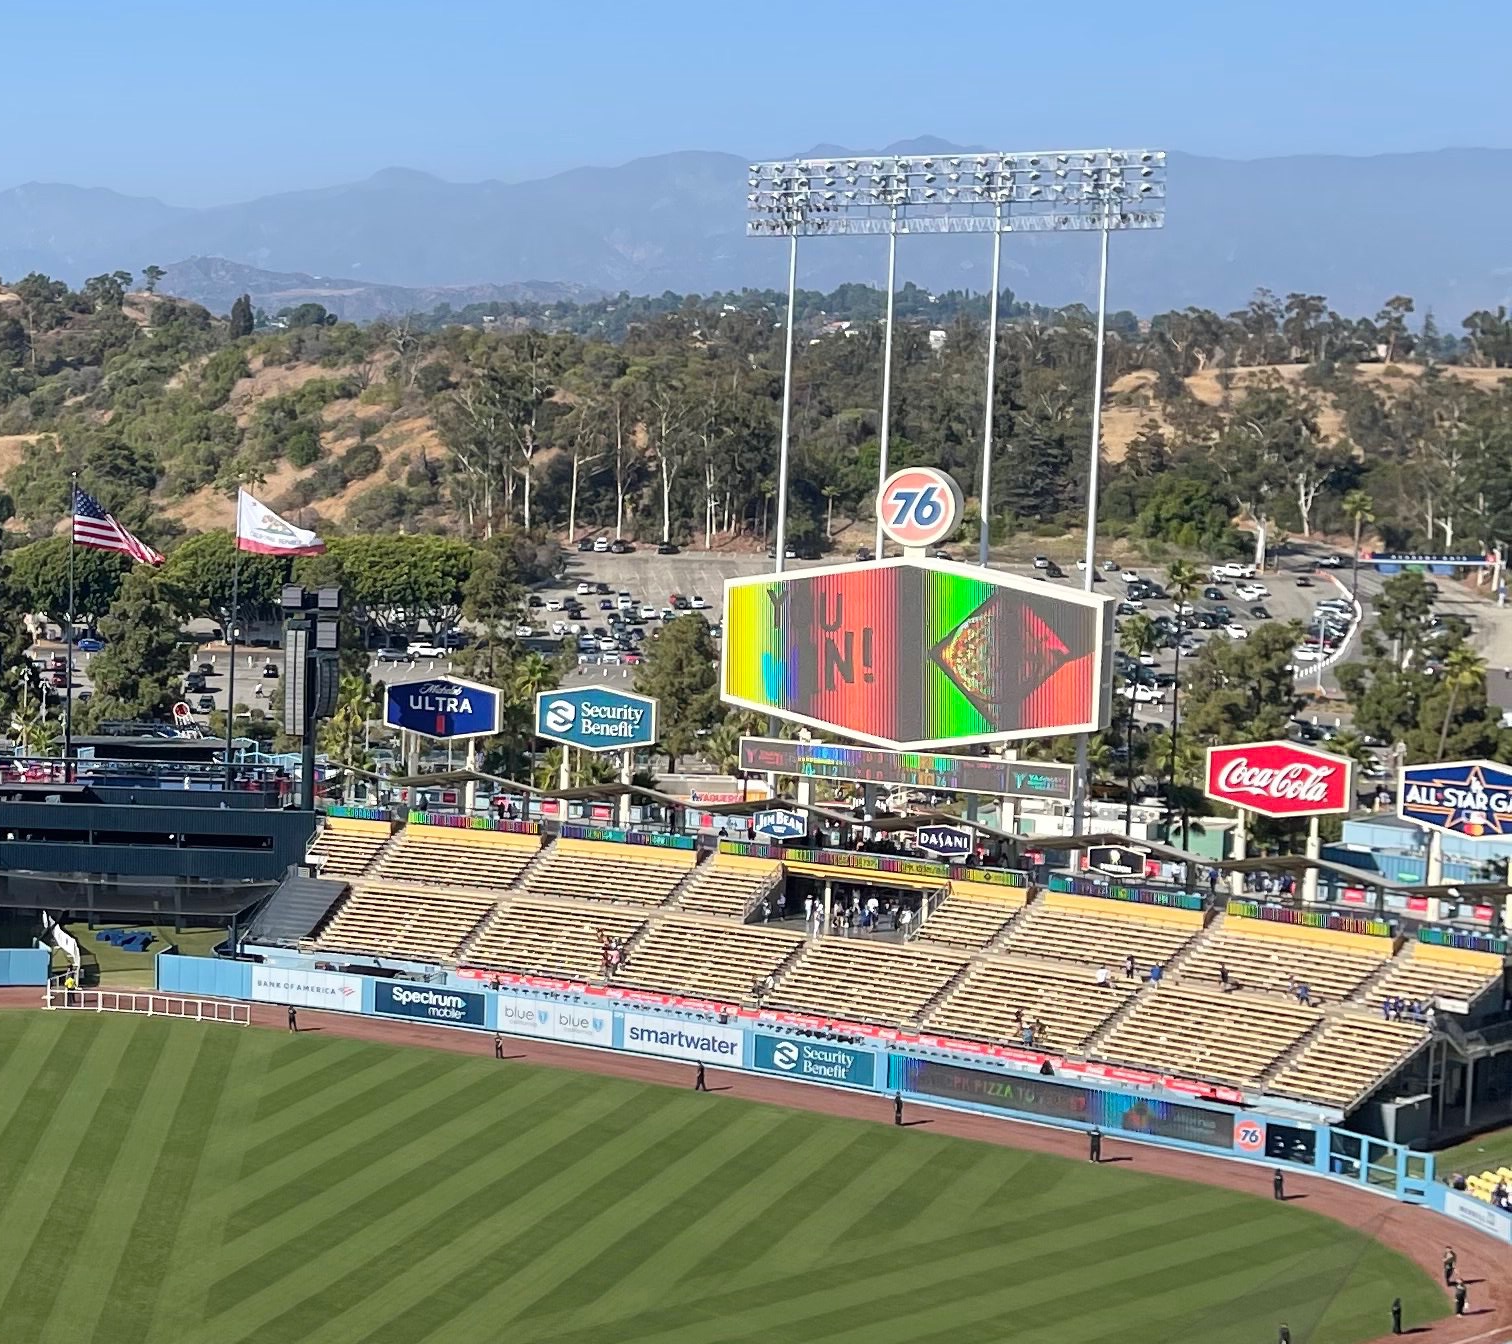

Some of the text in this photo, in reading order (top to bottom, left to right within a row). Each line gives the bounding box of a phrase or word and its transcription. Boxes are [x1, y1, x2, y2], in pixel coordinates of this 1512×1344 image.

[891, 485, 942, 527] 76
[409, 694, 473, 714] ULTRA
[581, 702, 643, 726] Security
[581, 720, 635, 738] Benefit
[1218, 757, 1336, 802] Coca-Cola
[756, 811, 804, 835] JIM BEAM
[919, 831, 969, 850] DASANI
[257, 979, 337, 995] BANK OF AMERICA
[392, 985, 462, 1009] Spectrum
[427, 1005, 462, 1019] mobile
[504, 1006, 535, 1021] blue
[559, 1012, 590, 1029] blue
[629, 1025, 737, 1056] smartwater
[802, 1045, 855, 1066] Security
[802, 1059, 848, 1079] Benefit
[1239, 1128, 1260, 1145] 76
